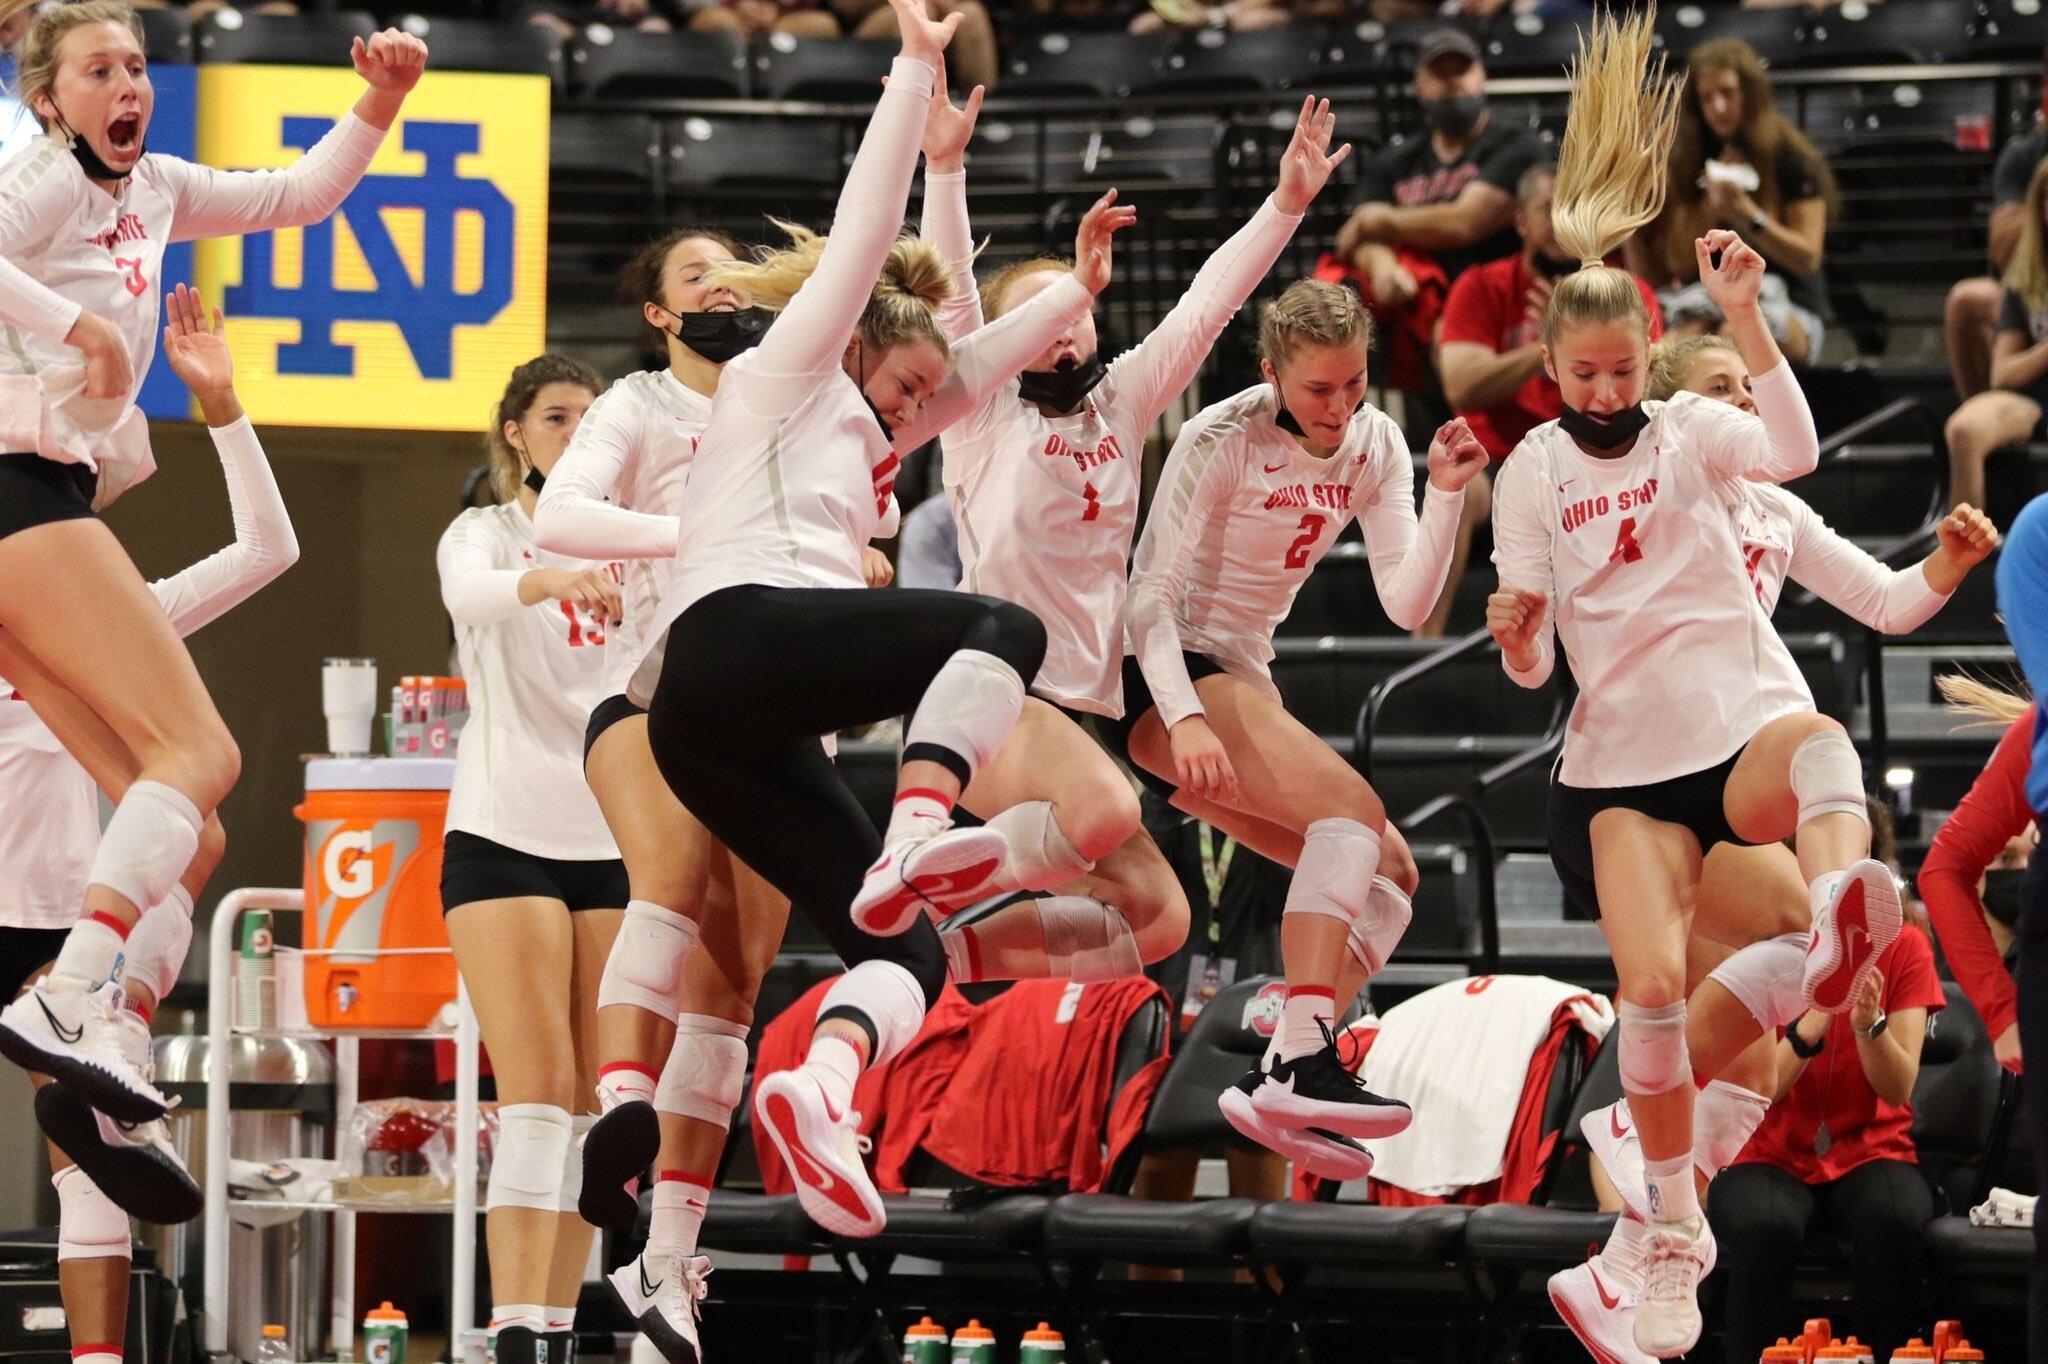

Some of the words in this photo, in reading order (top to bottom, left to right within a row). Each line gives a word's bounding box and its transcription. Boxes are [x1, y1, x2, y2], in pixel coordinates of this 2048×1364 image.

[1082, 481, 1100, 521] 1
[1264, 484, 1309, 510] OHIO
[1562, 496, 1609, 533] OHIO
[1284, 514, 1326, 569] 2
[1609, 517, 1643, 564] 4
[324, 830, 374, 900] G
[367, 1338, 390, 1364] G
